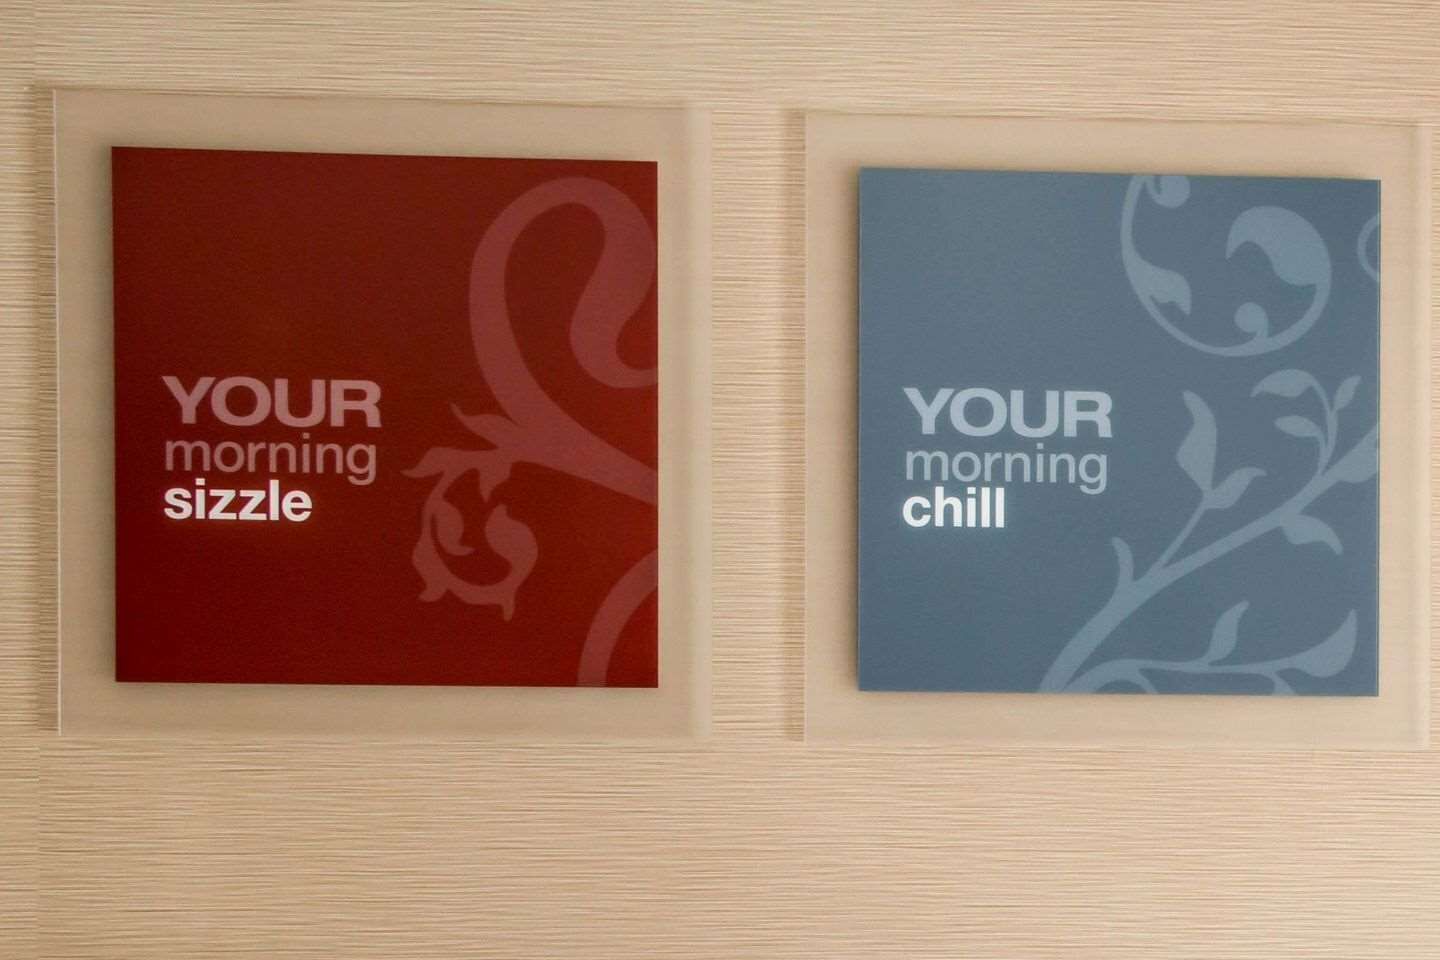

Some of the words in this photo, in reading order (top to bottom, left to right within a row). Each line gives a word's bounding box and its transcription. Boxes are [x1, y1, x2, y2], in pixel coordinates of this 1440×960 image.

[162, 376, 382, 428] YOUR
[903, 387, 1112, 438] YOUR
[165, 432, 377, 485] morning
[906, 442, 1107, 495] morning
[164, 478, 312, 521] sizzle
[903, 486, 1005, 528] chill
